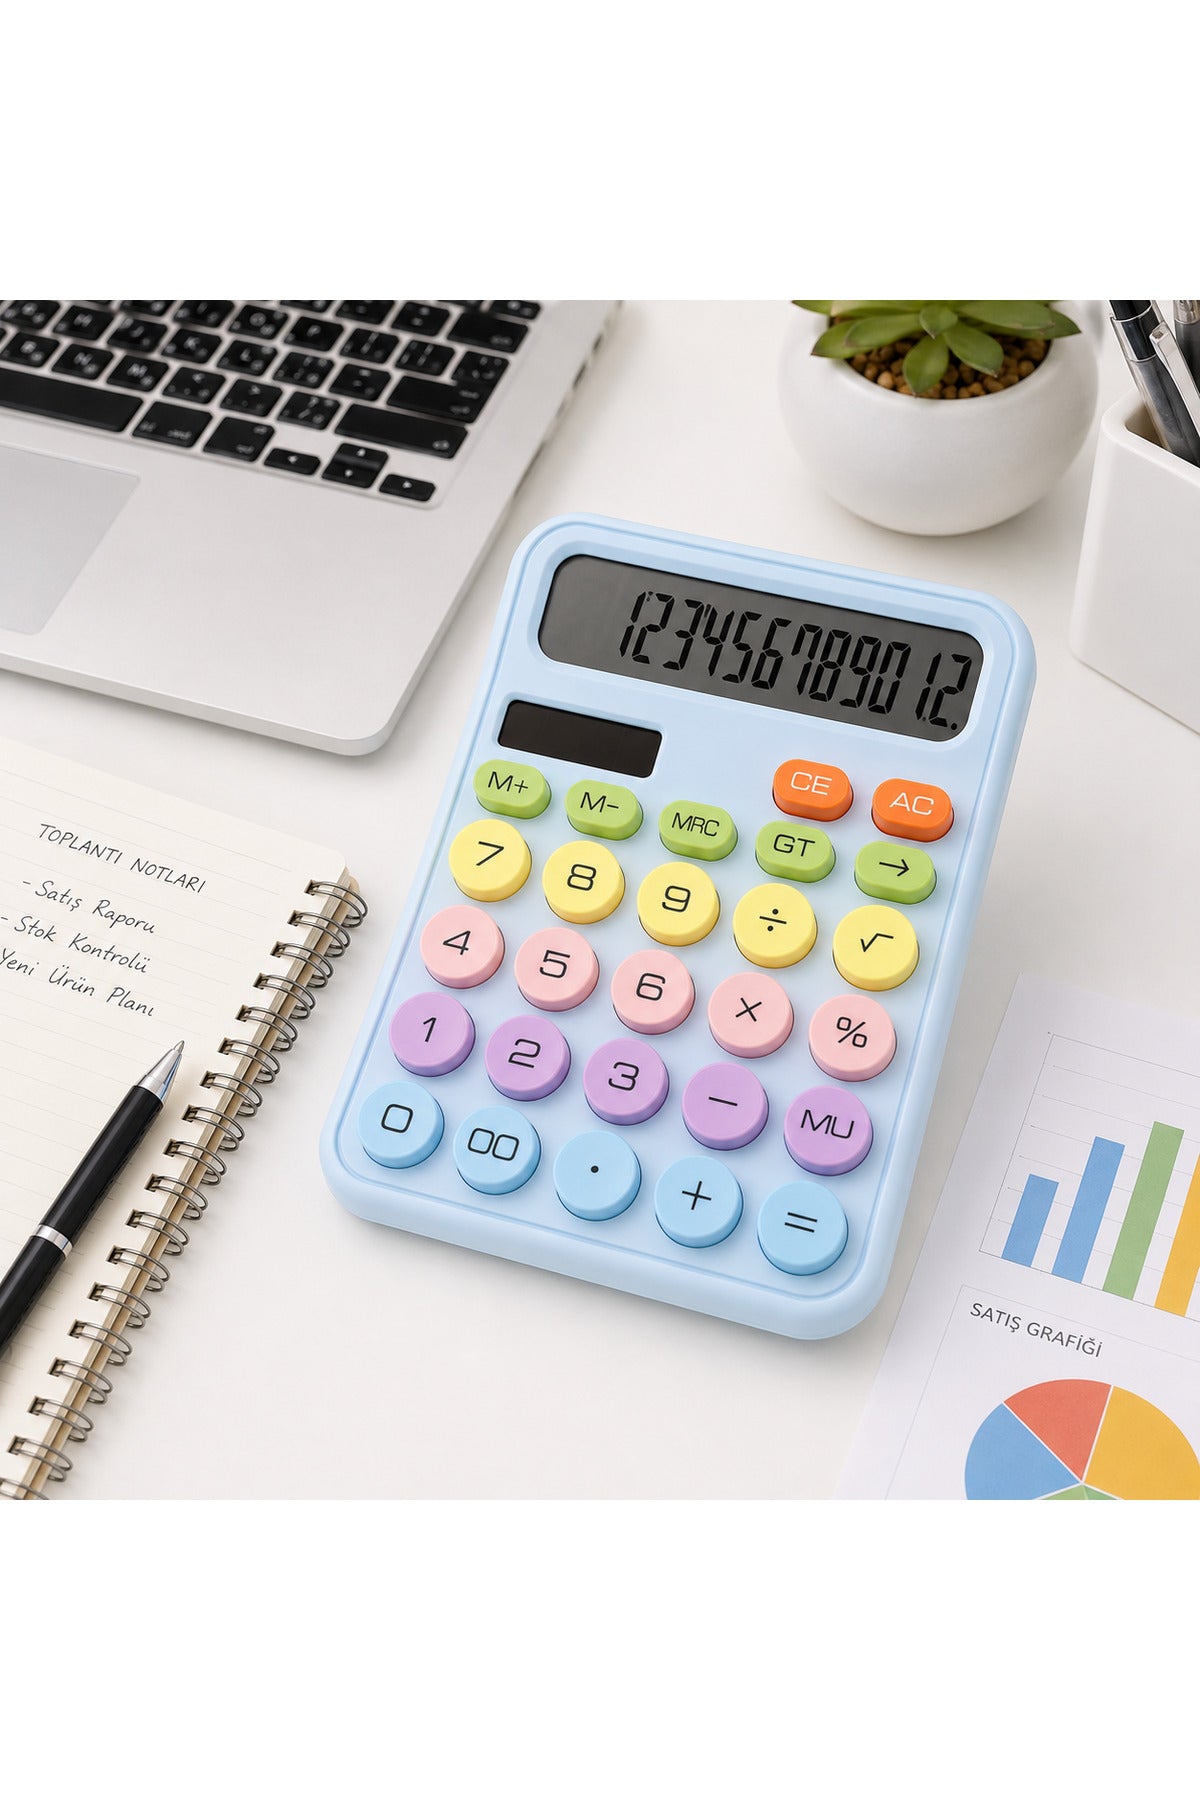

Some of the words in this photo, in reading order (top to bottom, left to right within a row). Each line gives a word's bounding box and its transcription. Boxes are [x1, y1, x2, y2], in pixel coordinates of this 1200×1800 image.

[488, 772, 528, 793] M+
[791, 771, 830, 795] CE
[890, 793, 934, 815] AC
[672, 813, 719, 836] MRC
[40, 824, 122, 864] TOPLANTI
[130, 858, 205, 893] NOTLARI
[476, 841, 504, 866] 7
[774, 834, 815, 856] GT
[567, 864, 596, 891] 8
[662, 886, 690, 912] 9
[93, 900, 154, 933] Raporu
[68, 932, 150, 973] Kontrolü
[443, 931, 470, 955] 4
[0, 948, 39, 975] Yeni
[49, 965, 94, 996] Ürün
[540, 950, 570, 978] 5
[636, 973, 665, 1001] 6
[423, 1018, 436, 1042] 1
[509, 1039, 540, 1068] 2
[609, 1062, 639, 1090] 3
[801, 1110, 854, 1138] MU
[971, 1303, 1021, 1332] SATIŞ
[1027, 1323, 1102, 1357] GRAFİĞİ
